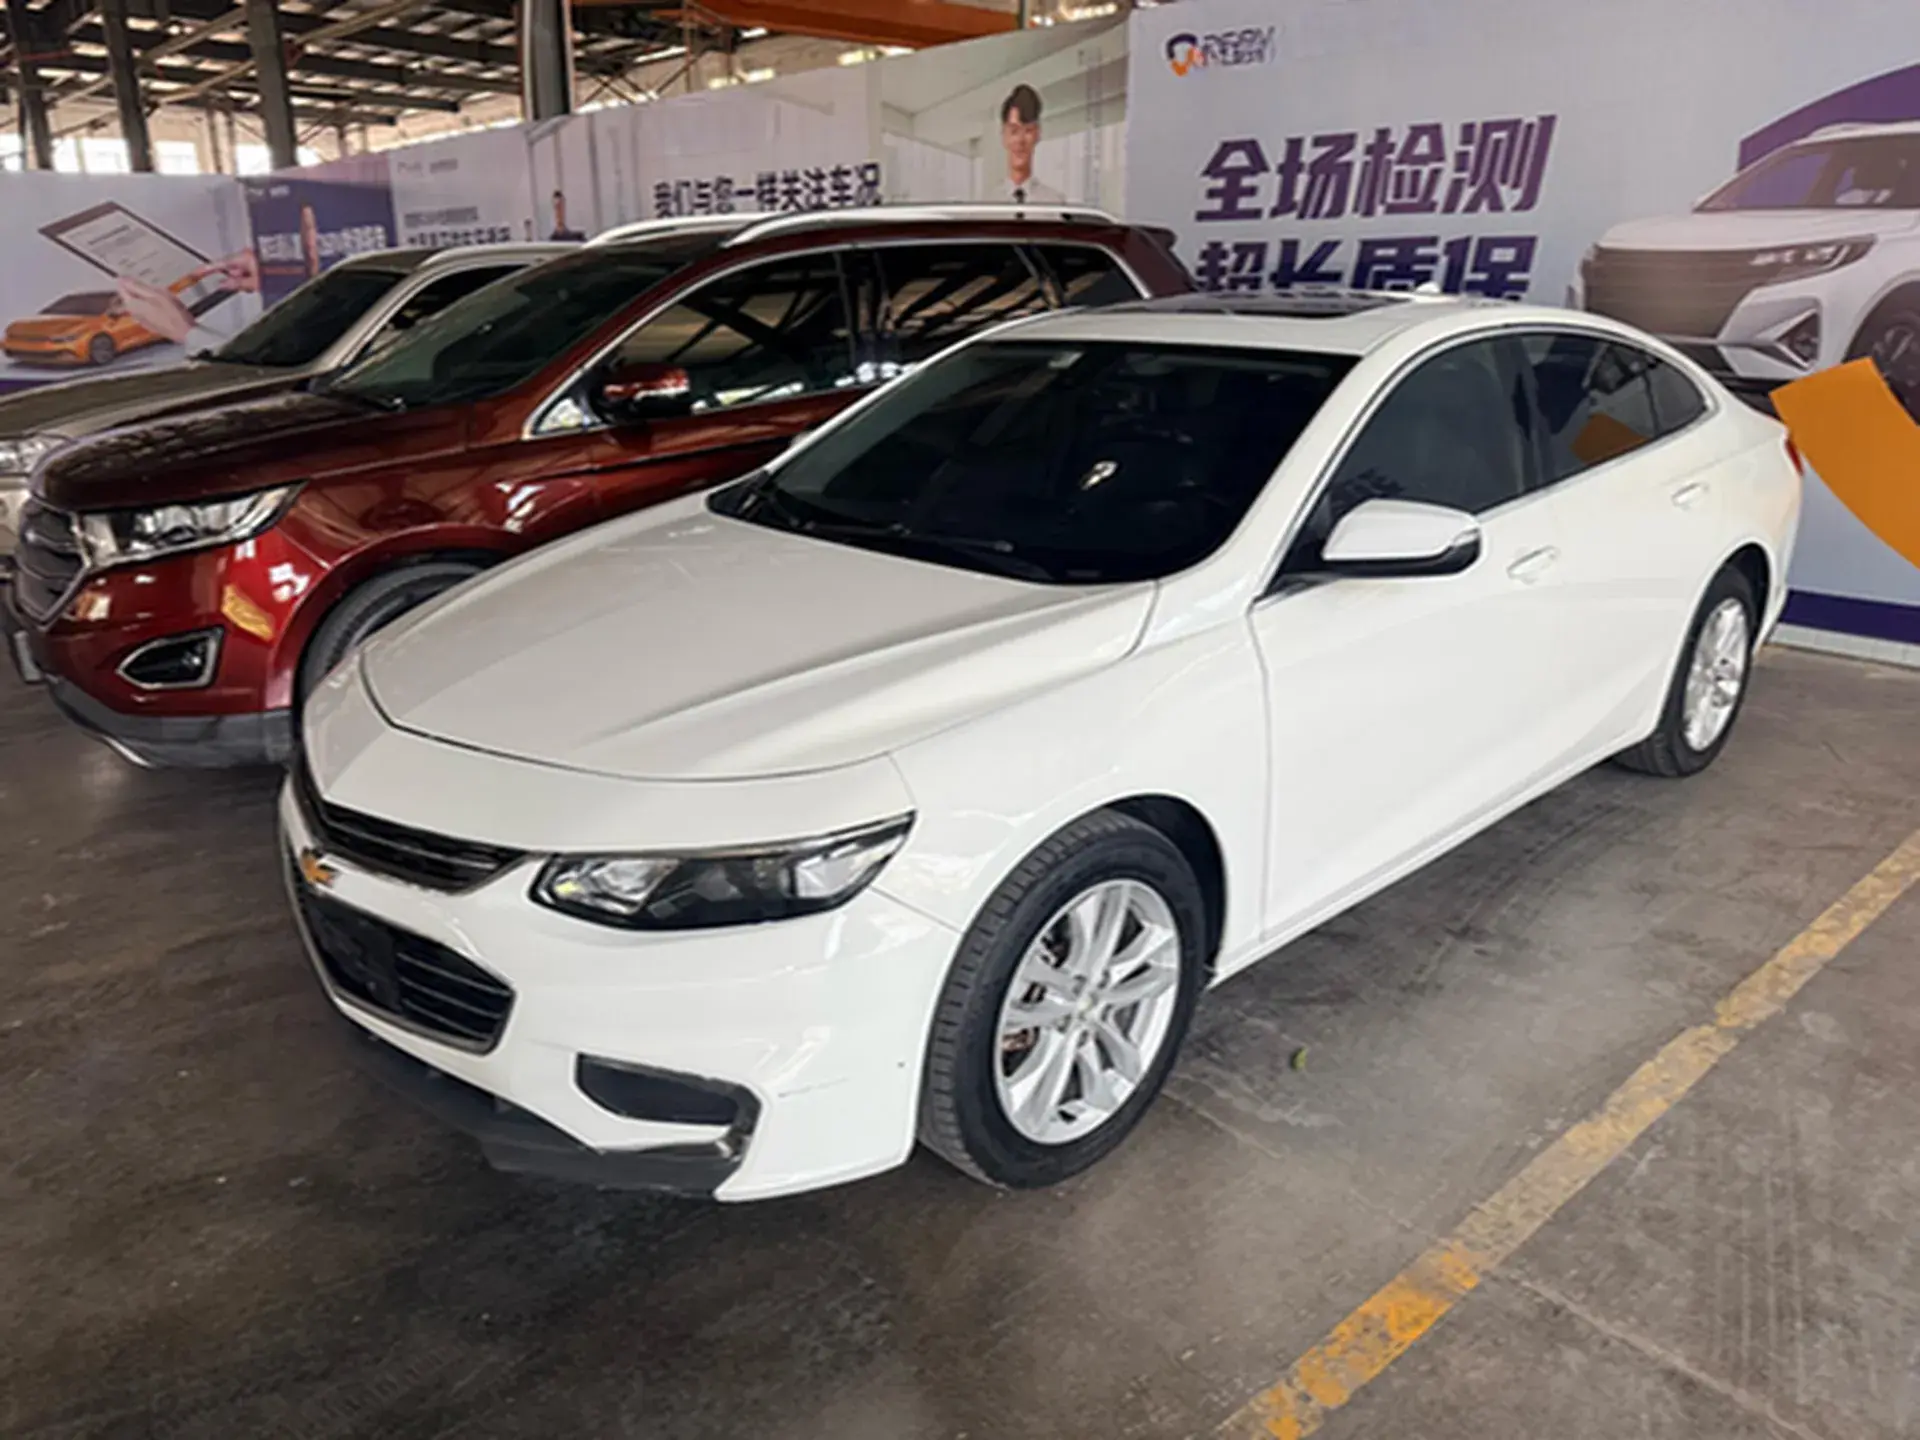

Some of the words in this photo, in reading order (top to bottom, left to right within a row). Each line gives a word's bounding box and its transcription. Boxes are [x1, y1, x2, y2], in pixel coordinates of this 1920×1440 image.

[1195, 114, 1557, 222] 全场检测
[1196, 235, 1538, 300] 超长质保
